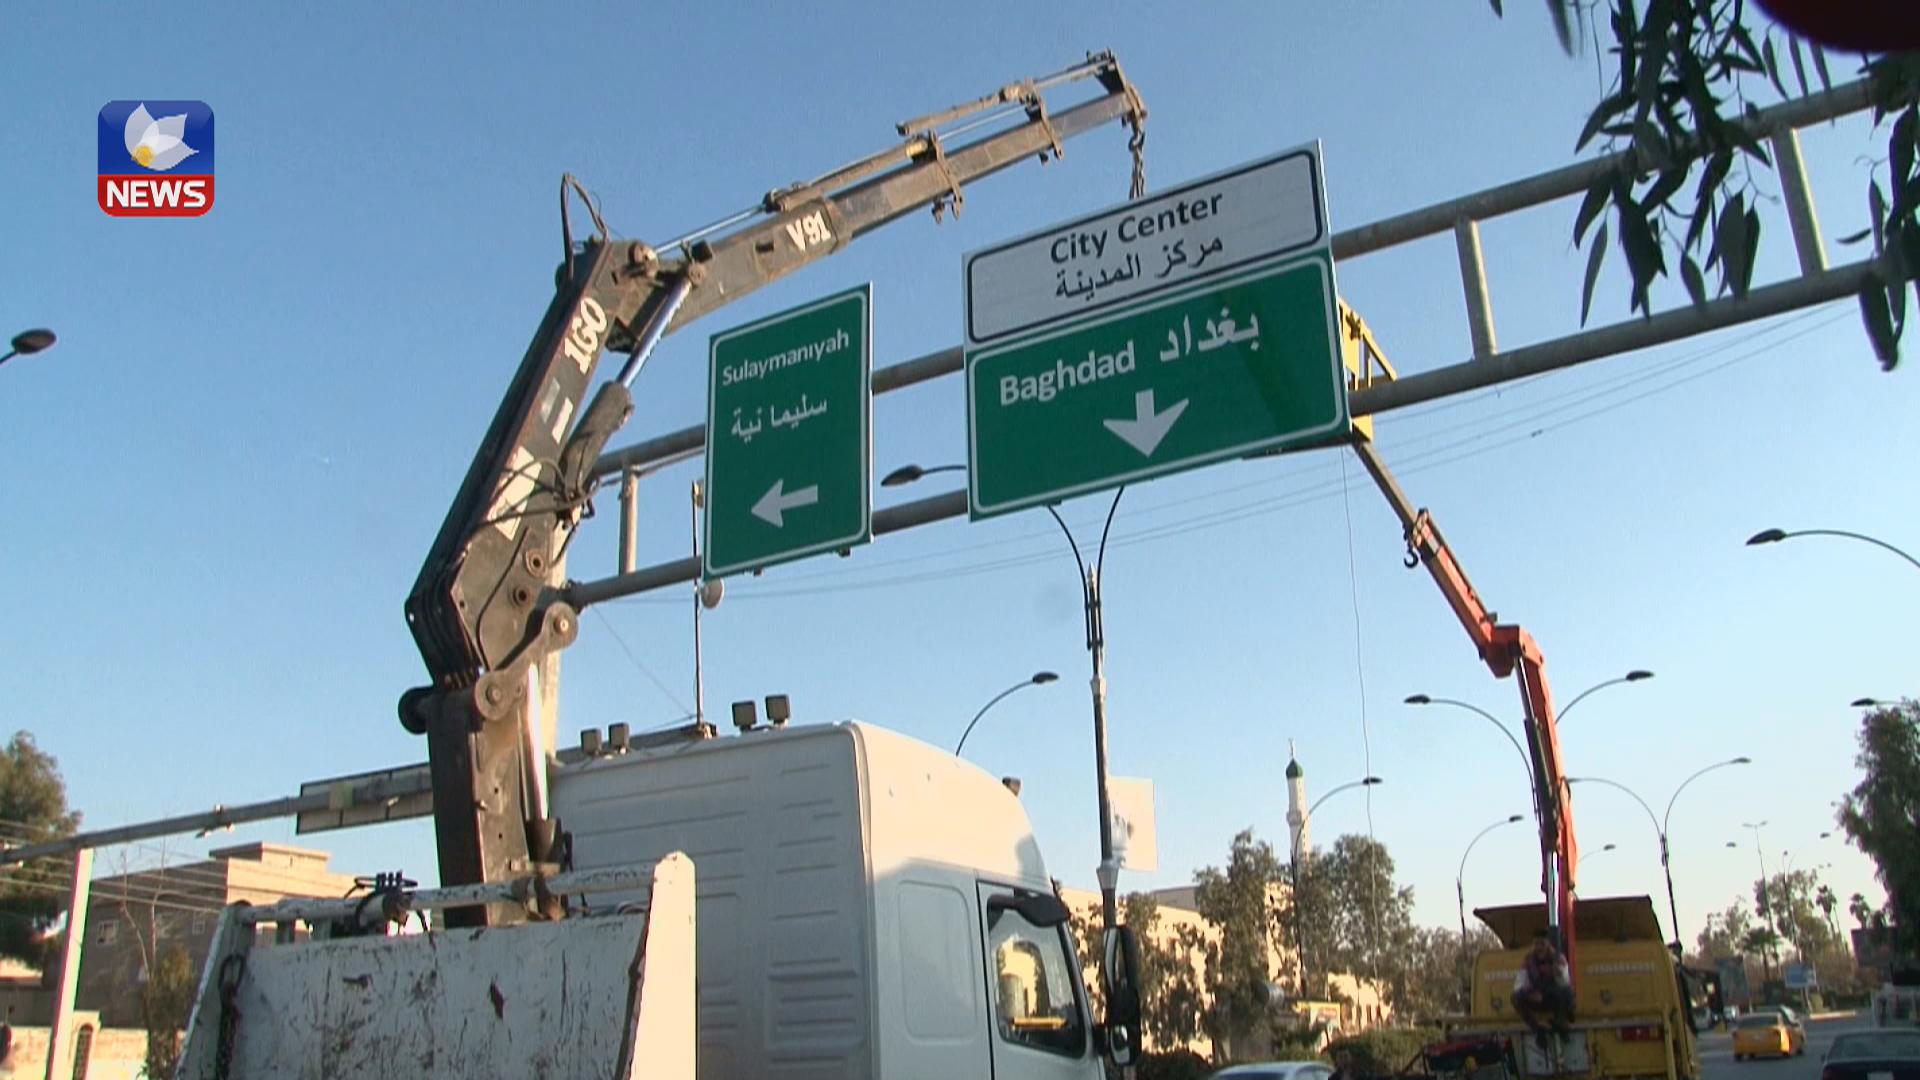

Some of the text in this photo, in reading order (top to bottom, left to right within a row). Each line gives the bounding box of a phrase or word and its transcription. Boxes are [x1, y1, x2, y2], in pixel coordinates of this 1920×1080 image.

[1051, 193, 1222, 264] City Center
[1055, 237, 1223, 301] مركز المدينة
[1159, 306, 1259, 362] بغداد
[1000, 339, 1136, 406] Baghdad
